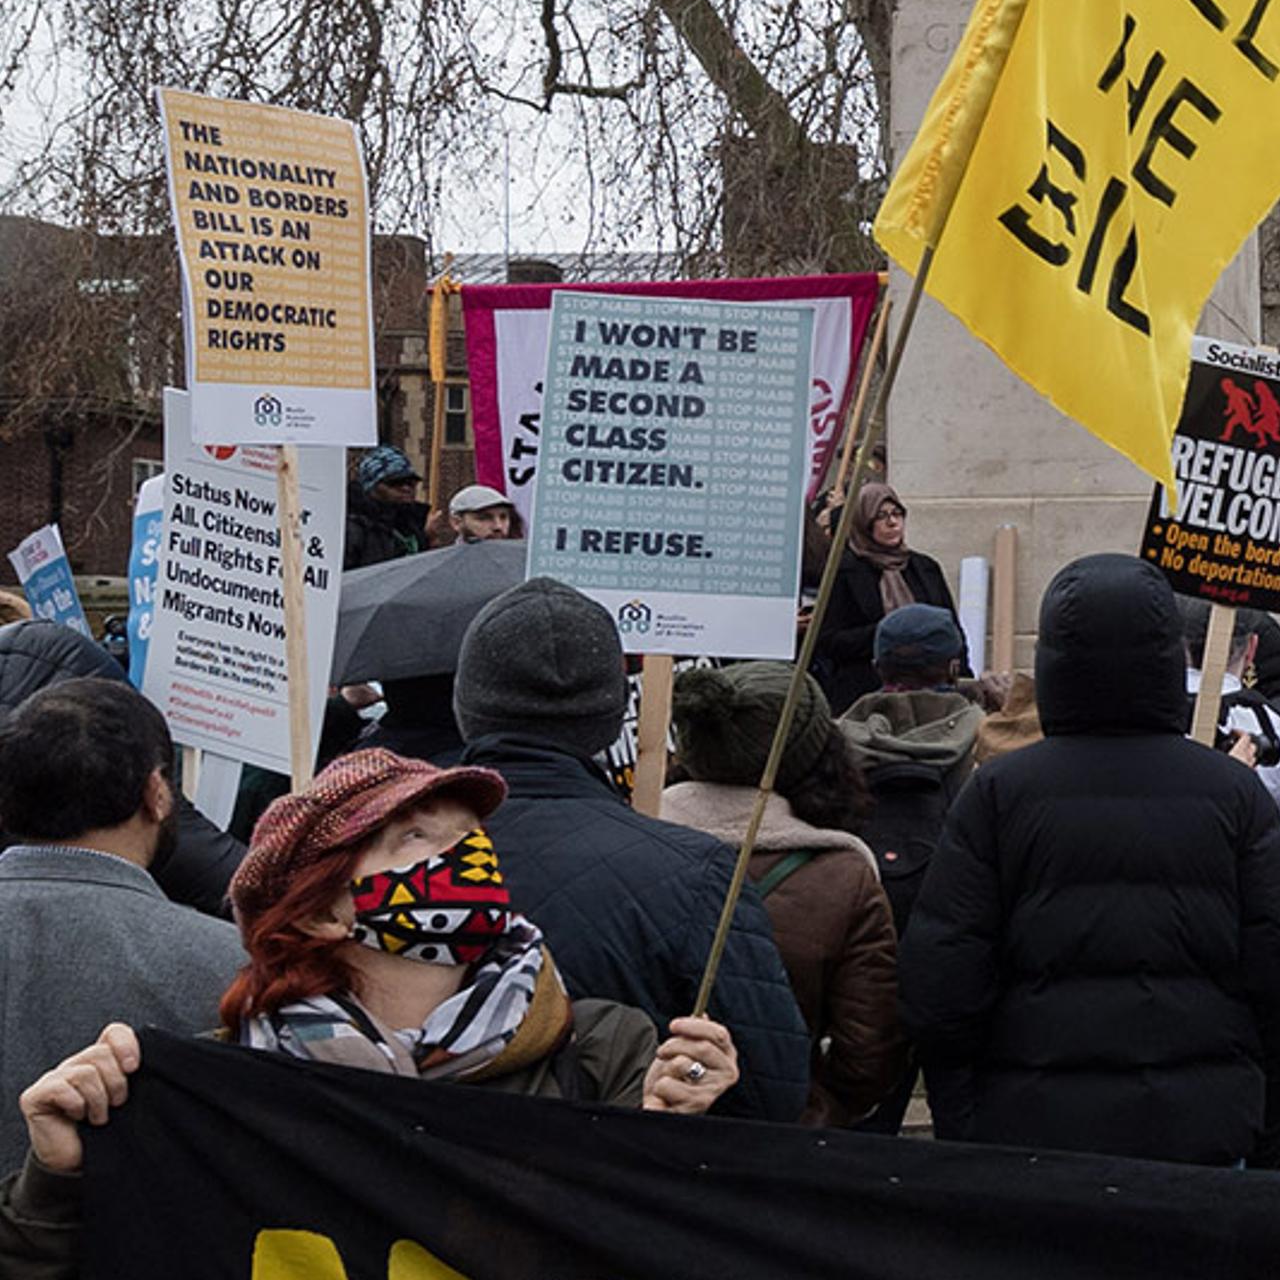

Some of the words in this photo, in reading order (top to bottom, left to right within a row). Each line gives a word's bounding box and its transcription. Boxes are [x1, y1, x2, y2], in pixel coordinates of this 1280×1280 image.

[179, 121, 222, 146] THE
[185, 150, 336, 189] NATIONALITY
[189, 180, 240, 204] AND
[247, 188, 349, 219] BORDERS
[193, 210, 244, 234] BILL
[250, 217, 274, 236] IS
[280, 220, 311, 241] AN
[997, 117, 1152, 338] BIL
[199, 241, 285, 267] ATTACK
[291, 249, 321, 270] ON
[204, 269, 254, 292] OUR
[207, 299, 337, 329] DEMOCRATIC
[207, 329, 286, 353] RIGHTS
[574, 320, 587, 344] I
[598, 321, 707, 352] WON'T
[717, 329, 758, 354] BE
[569, 355, 670, 383] MADE
[678, 361, 705, 385] A
[566, 388, 707, 419] SECOND
[508, 381, 543, 487] STA
[564, 423, 668, 452] CLASS
[560, 458, 705, 489] CITIZEN.
[172, 473, 232, 507] Status
[235, 489, 276, 517] Now
[170, 503, 200, 529] All.
[307, 536, 325, 559] &
[555, 527, 568, 552] I
[580, 528, 713, 560] REFUSE.
[1166, 523, 1208, 552] Open
[1213, 534, 1241, 560] the
[169, 531, 200, 558] Full
[203, 540, 264, 574] Rights
[302, 565, 330, 591] All
[1160, 548, 1186, 572] No
[166, 560, 286, 610] Undocument
[162, 589, 244, 630] Migrants
[247, 611, 287, 641] Now
